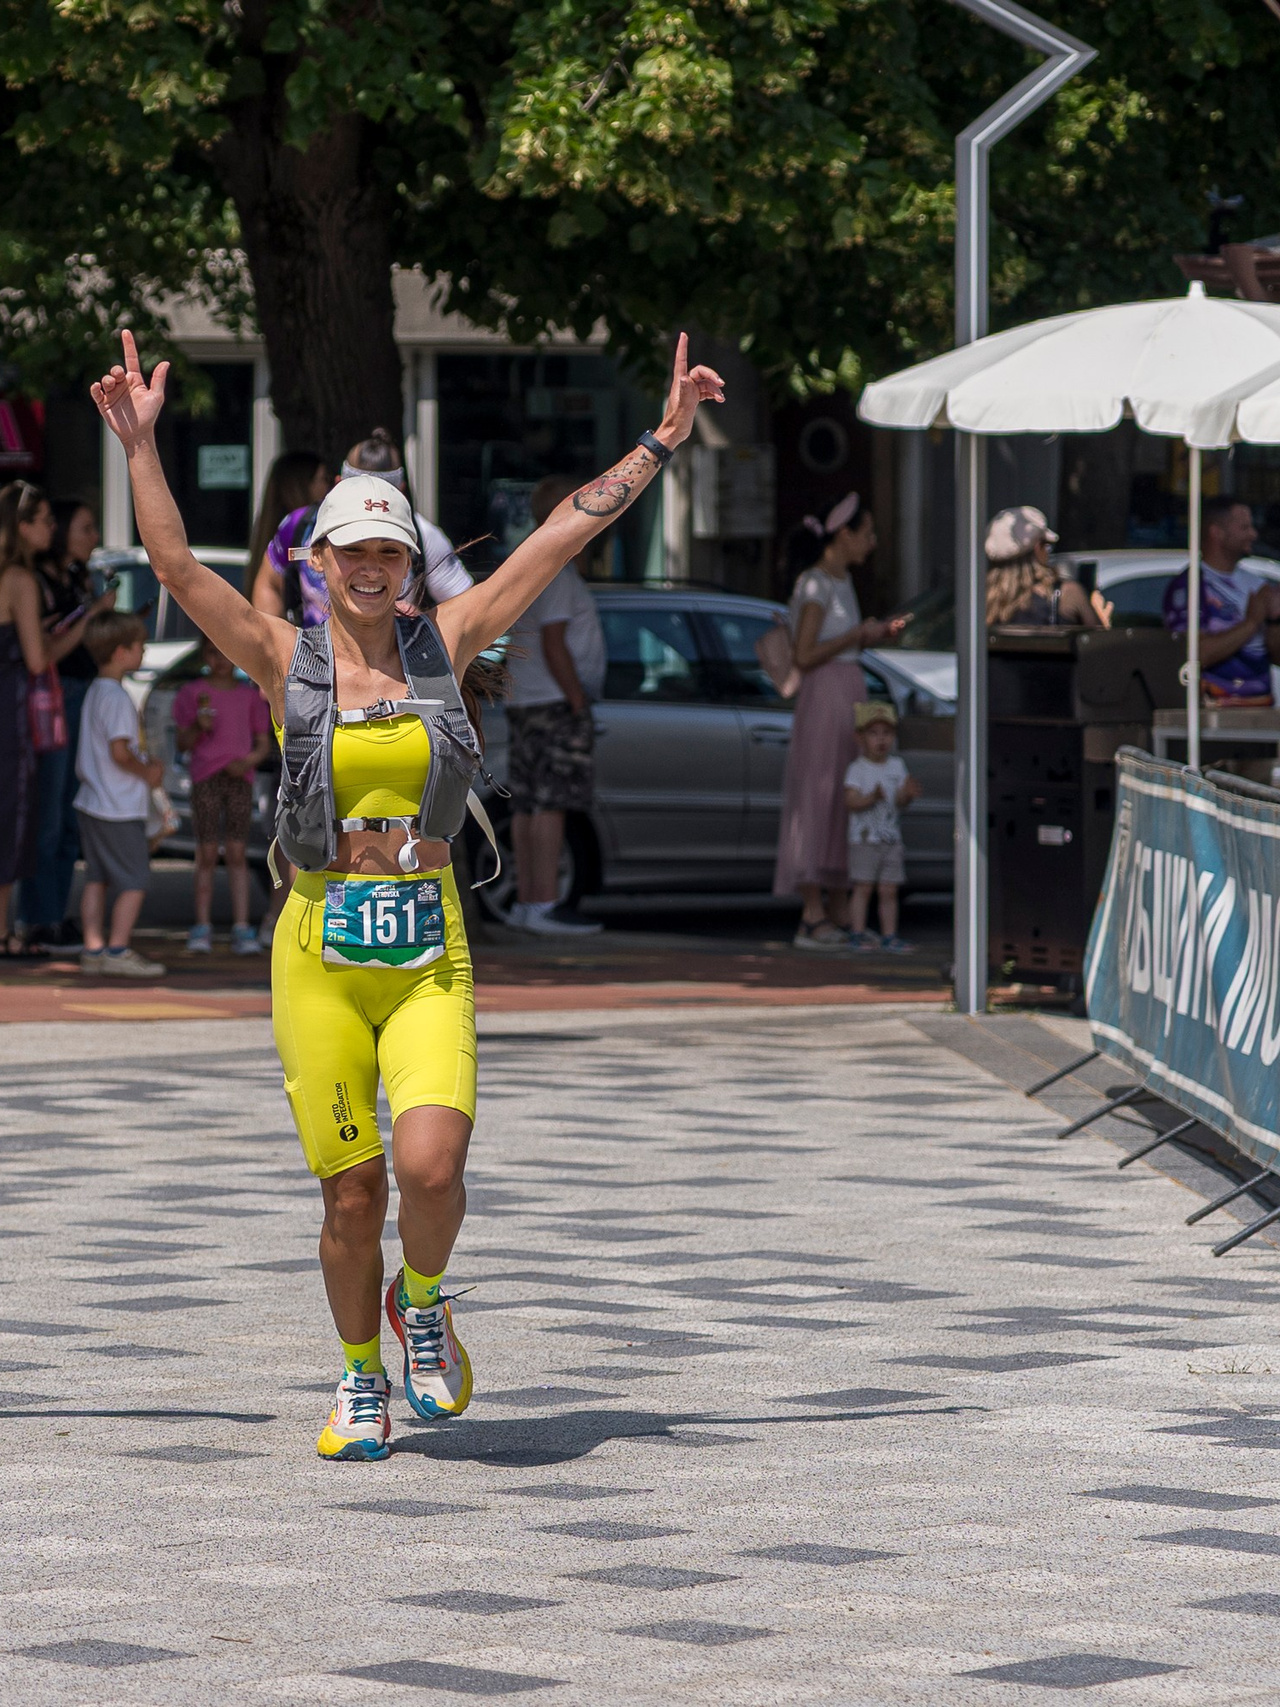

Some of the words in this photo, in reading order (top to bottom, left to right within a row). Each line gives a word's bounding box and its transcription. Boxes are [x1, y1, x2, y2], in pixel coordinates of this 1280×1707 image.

[372, 890, 400, 898] PETROVSKA
[358, 899, 415, 944] 151
[327, 931, 337, 941] 21
[335, 1082, 349, 1122] INTEGRATOR
[332, 1103, 342, 1124] MOTO
